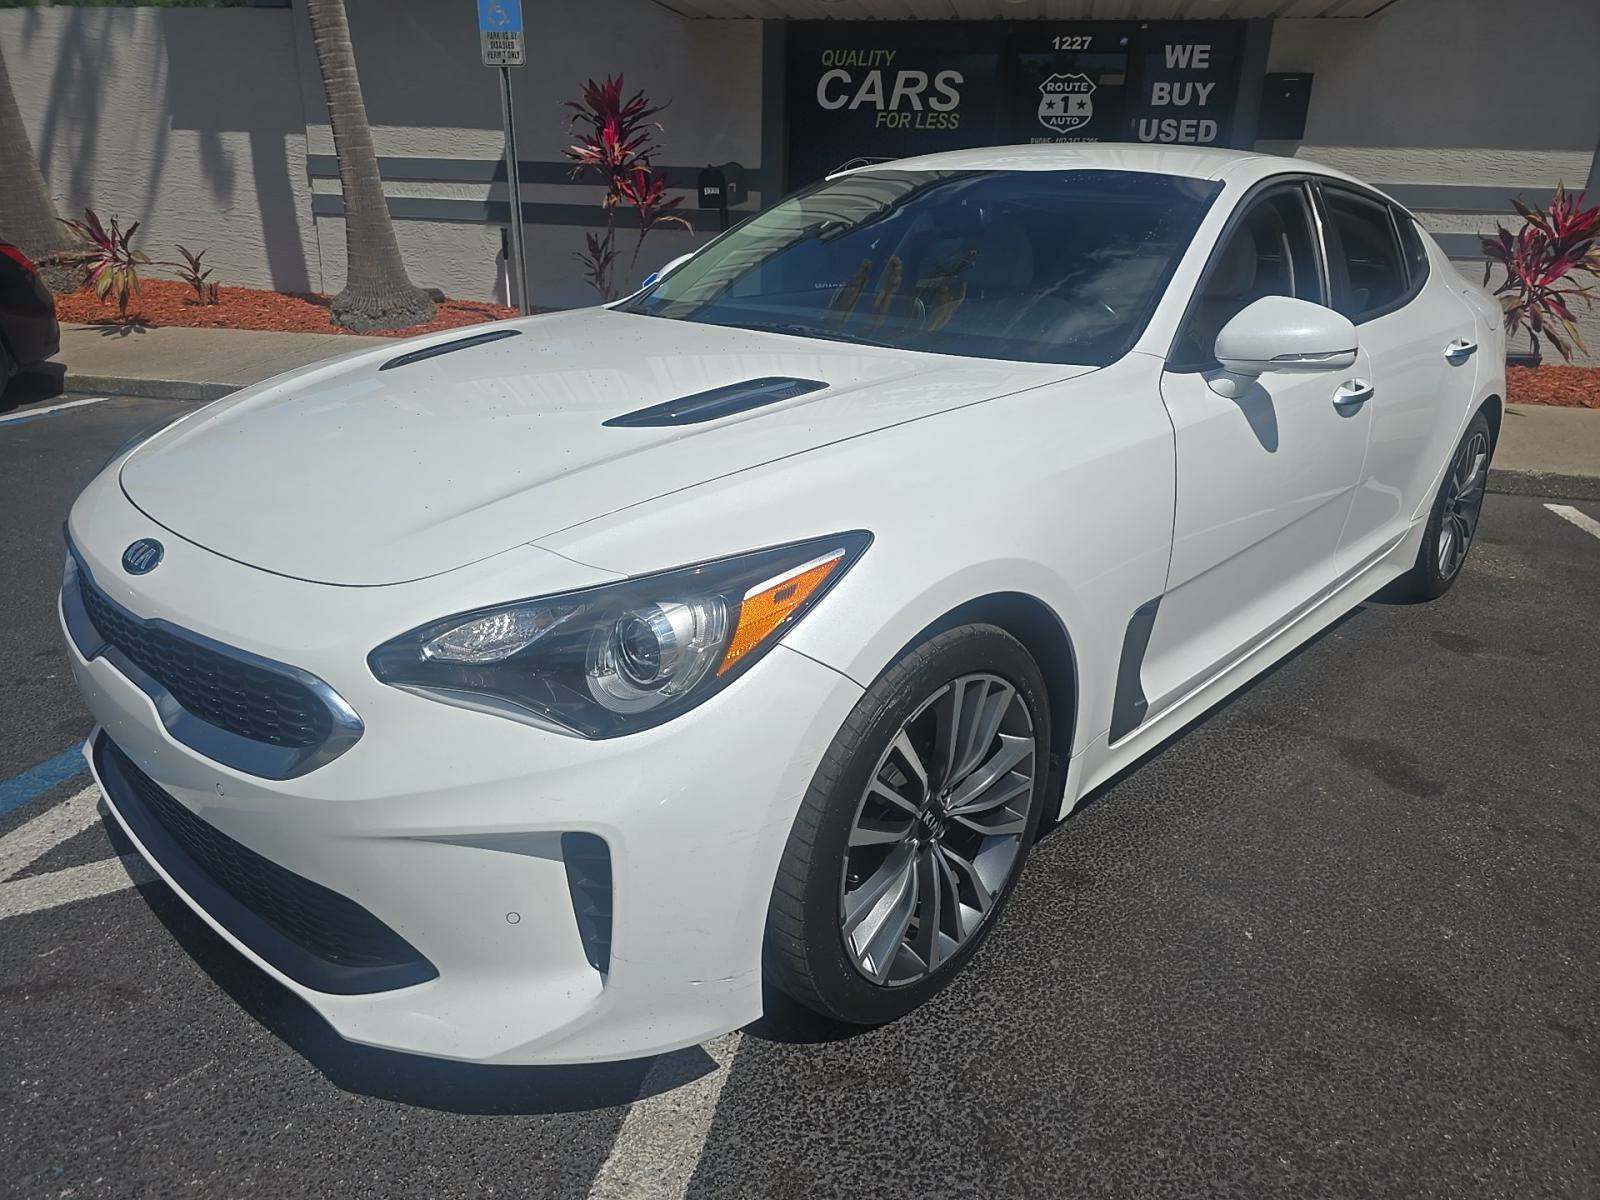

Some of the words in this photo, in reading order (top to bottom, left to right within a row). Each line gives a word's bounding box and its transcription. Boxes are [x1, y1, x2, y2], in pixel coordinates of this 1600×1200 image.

[1052, 36, 1093, 50] 1227
[821, 50, 896, 66] QUALITY
[1165, 45, 1211, 68] WE
[816, 69, 964, 111] CARS
[1046, 82, 1089, 92] ROUTE
[1151, 82, 1216, 106] BUY
[1060, 95, 1070, 114] 1
[875, 112, 911, 128] FOR
[915, 112, 960, 129] LESS
[1049, 116, 1080, 125] AUTO
[1138, 118, 1218, 143] USED
